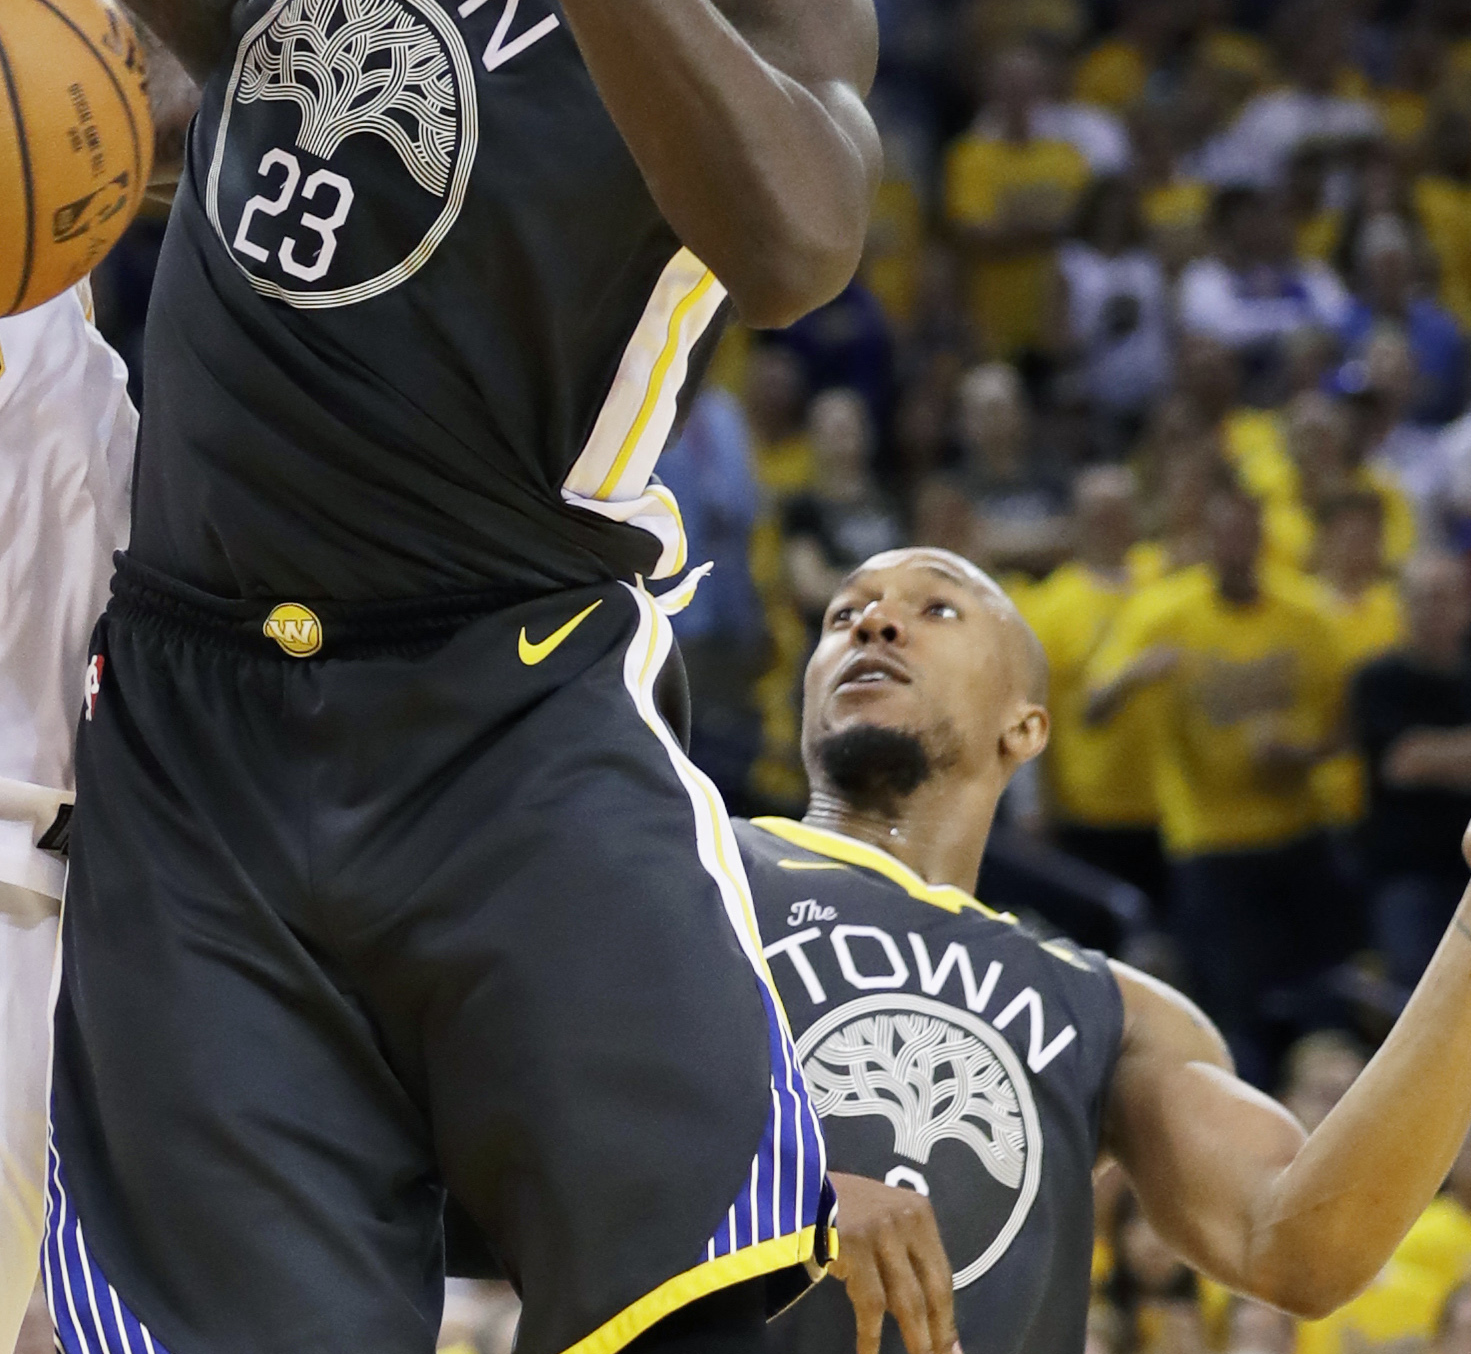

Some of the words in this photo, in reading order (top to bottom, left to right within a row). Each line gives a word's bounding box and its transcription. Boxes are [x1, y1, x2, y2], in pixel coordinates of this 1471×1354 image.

[233, 148, 354, 282] 23
[786, 898, 839, 926] The
[760, 924, 1078, 1074] TOWN
